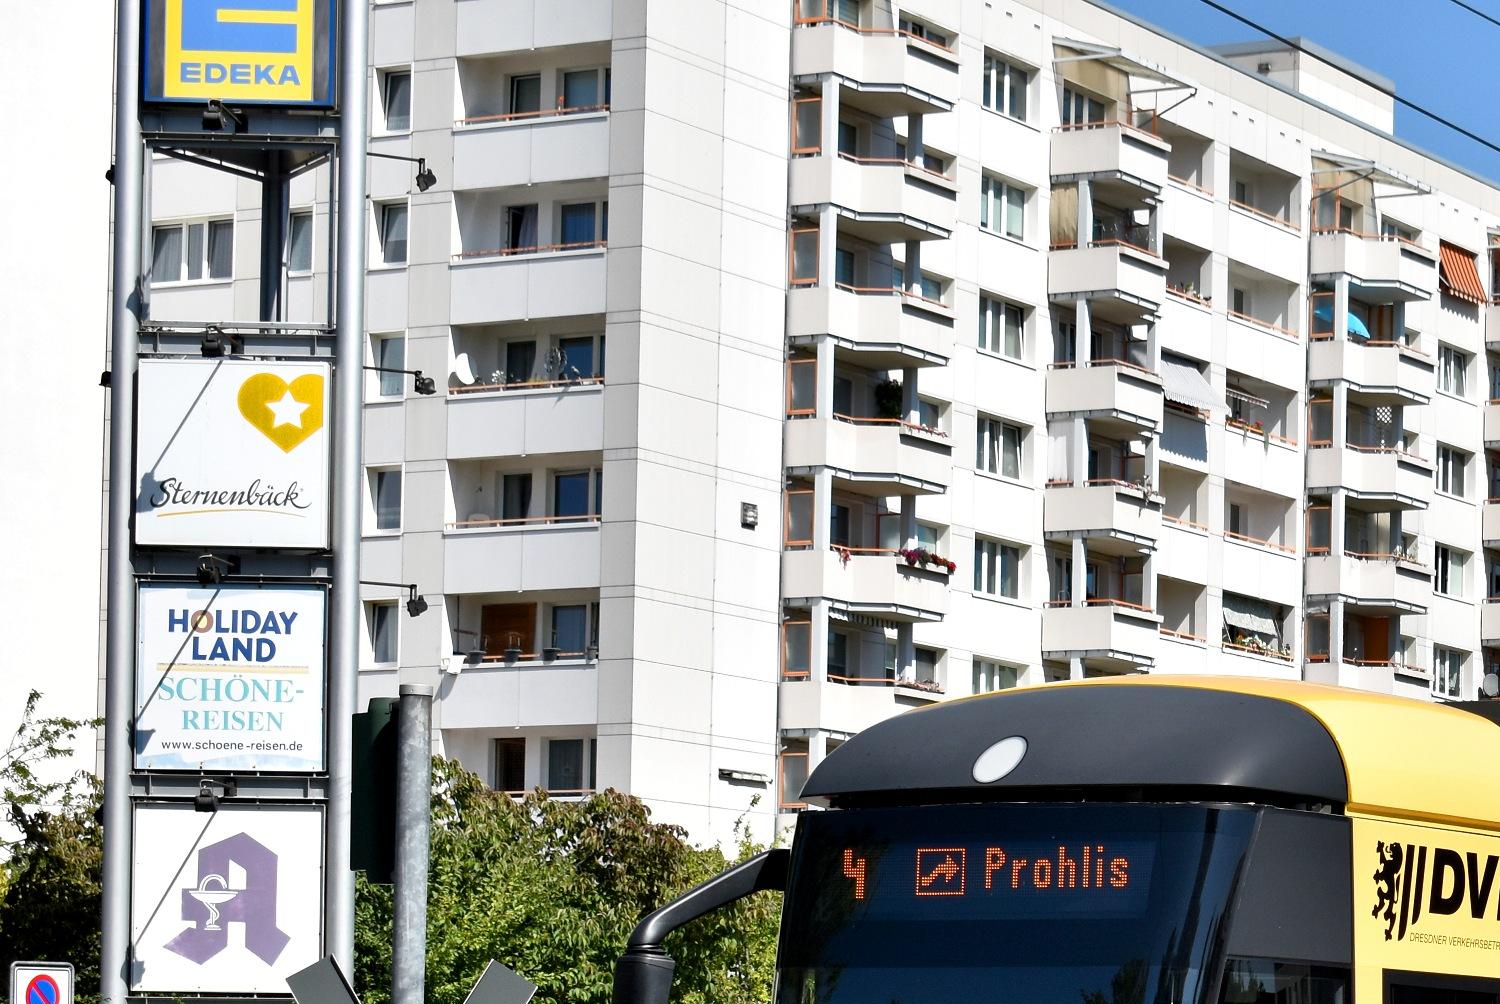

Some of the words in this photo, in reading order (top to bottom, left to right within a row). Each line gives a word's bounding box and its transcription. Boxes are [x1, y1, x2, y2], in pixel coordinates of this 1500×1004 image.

[180, 62, 301, 86] EDEKA
[150, 477, 312, 509] Sternenbäck
[168, 609, 298, 634] HOLIDAY
[192, 636, 277, 662] LAND
[158, 674, 304, 703] SCHÖNE-
[181, 710, 285, 731] REISEN
[161, 740, 303, 751] www.schoene-reisen.de
[843, 848, 865, 899] 4
[985, 846, 1129, 888] Prohlis
[1409, 932, 1447, 945] DRESDNER
